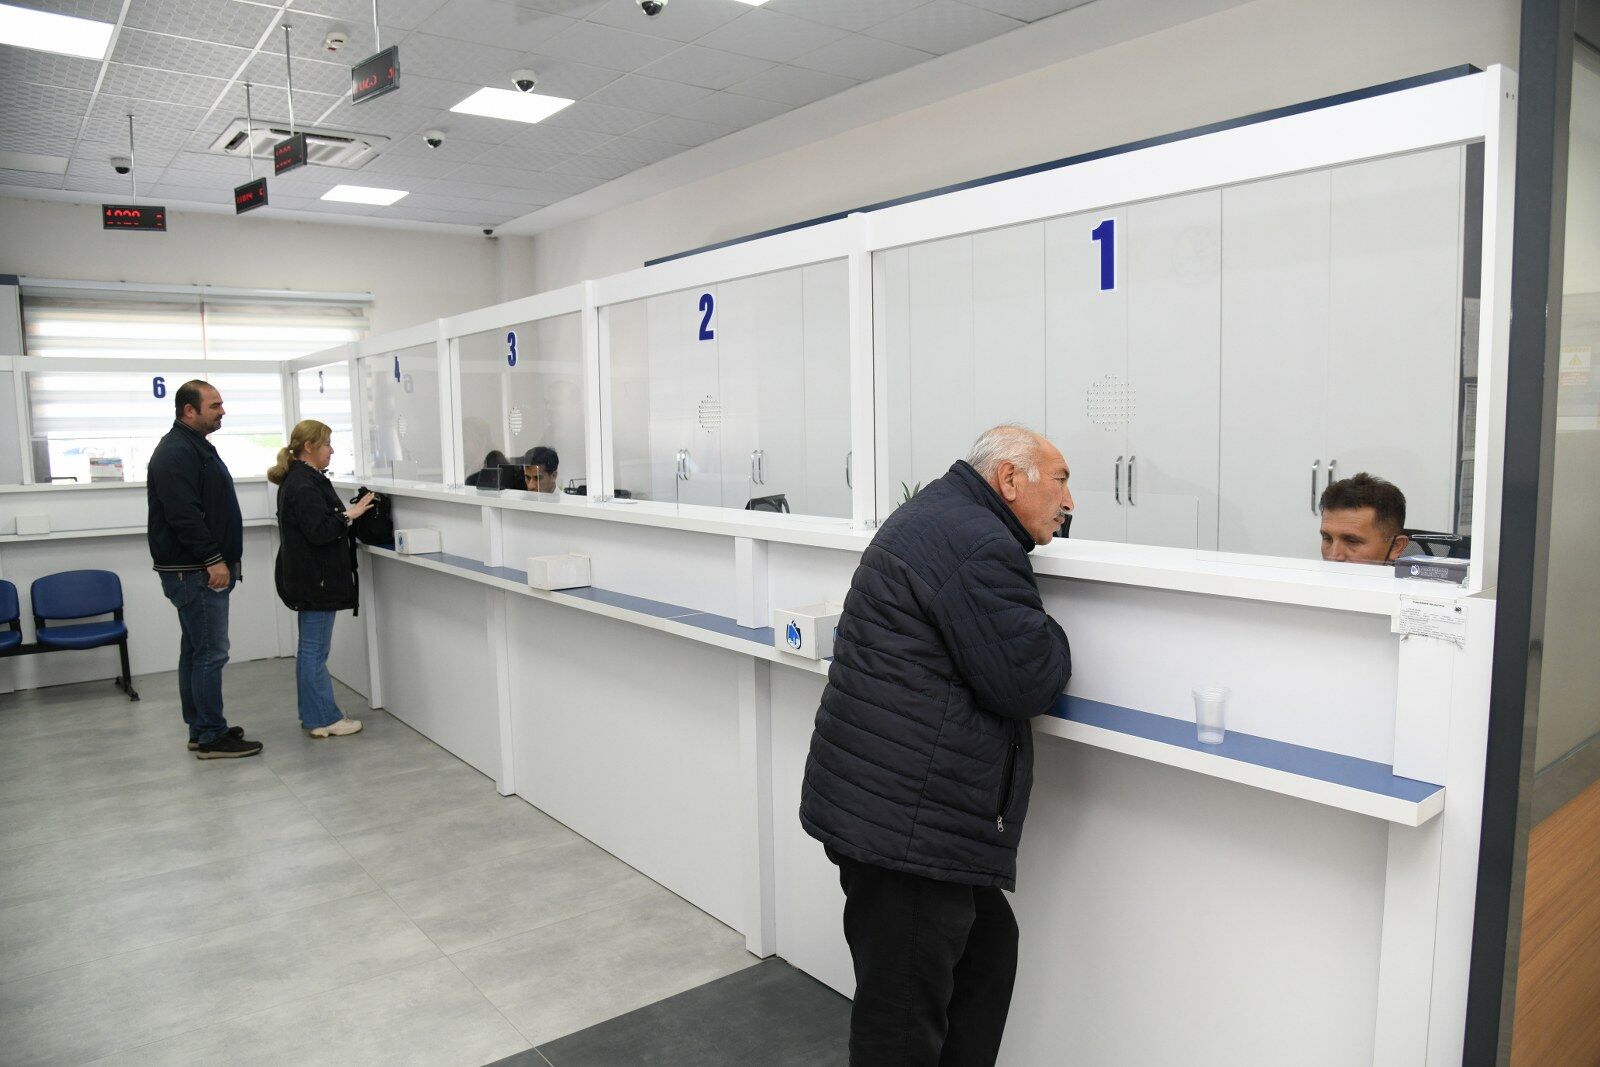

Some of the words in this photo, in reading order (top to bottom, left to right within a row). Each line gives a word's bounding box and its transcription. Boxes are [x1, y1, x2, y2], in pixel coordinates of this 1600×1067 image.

[1091, 219, 1116, 290] 1
[698, 293, 715, 341] 2
[507, 331, 518, 366] 3
[395, 356, 400, 382] 4
[153, 377, 166, 398] 6
